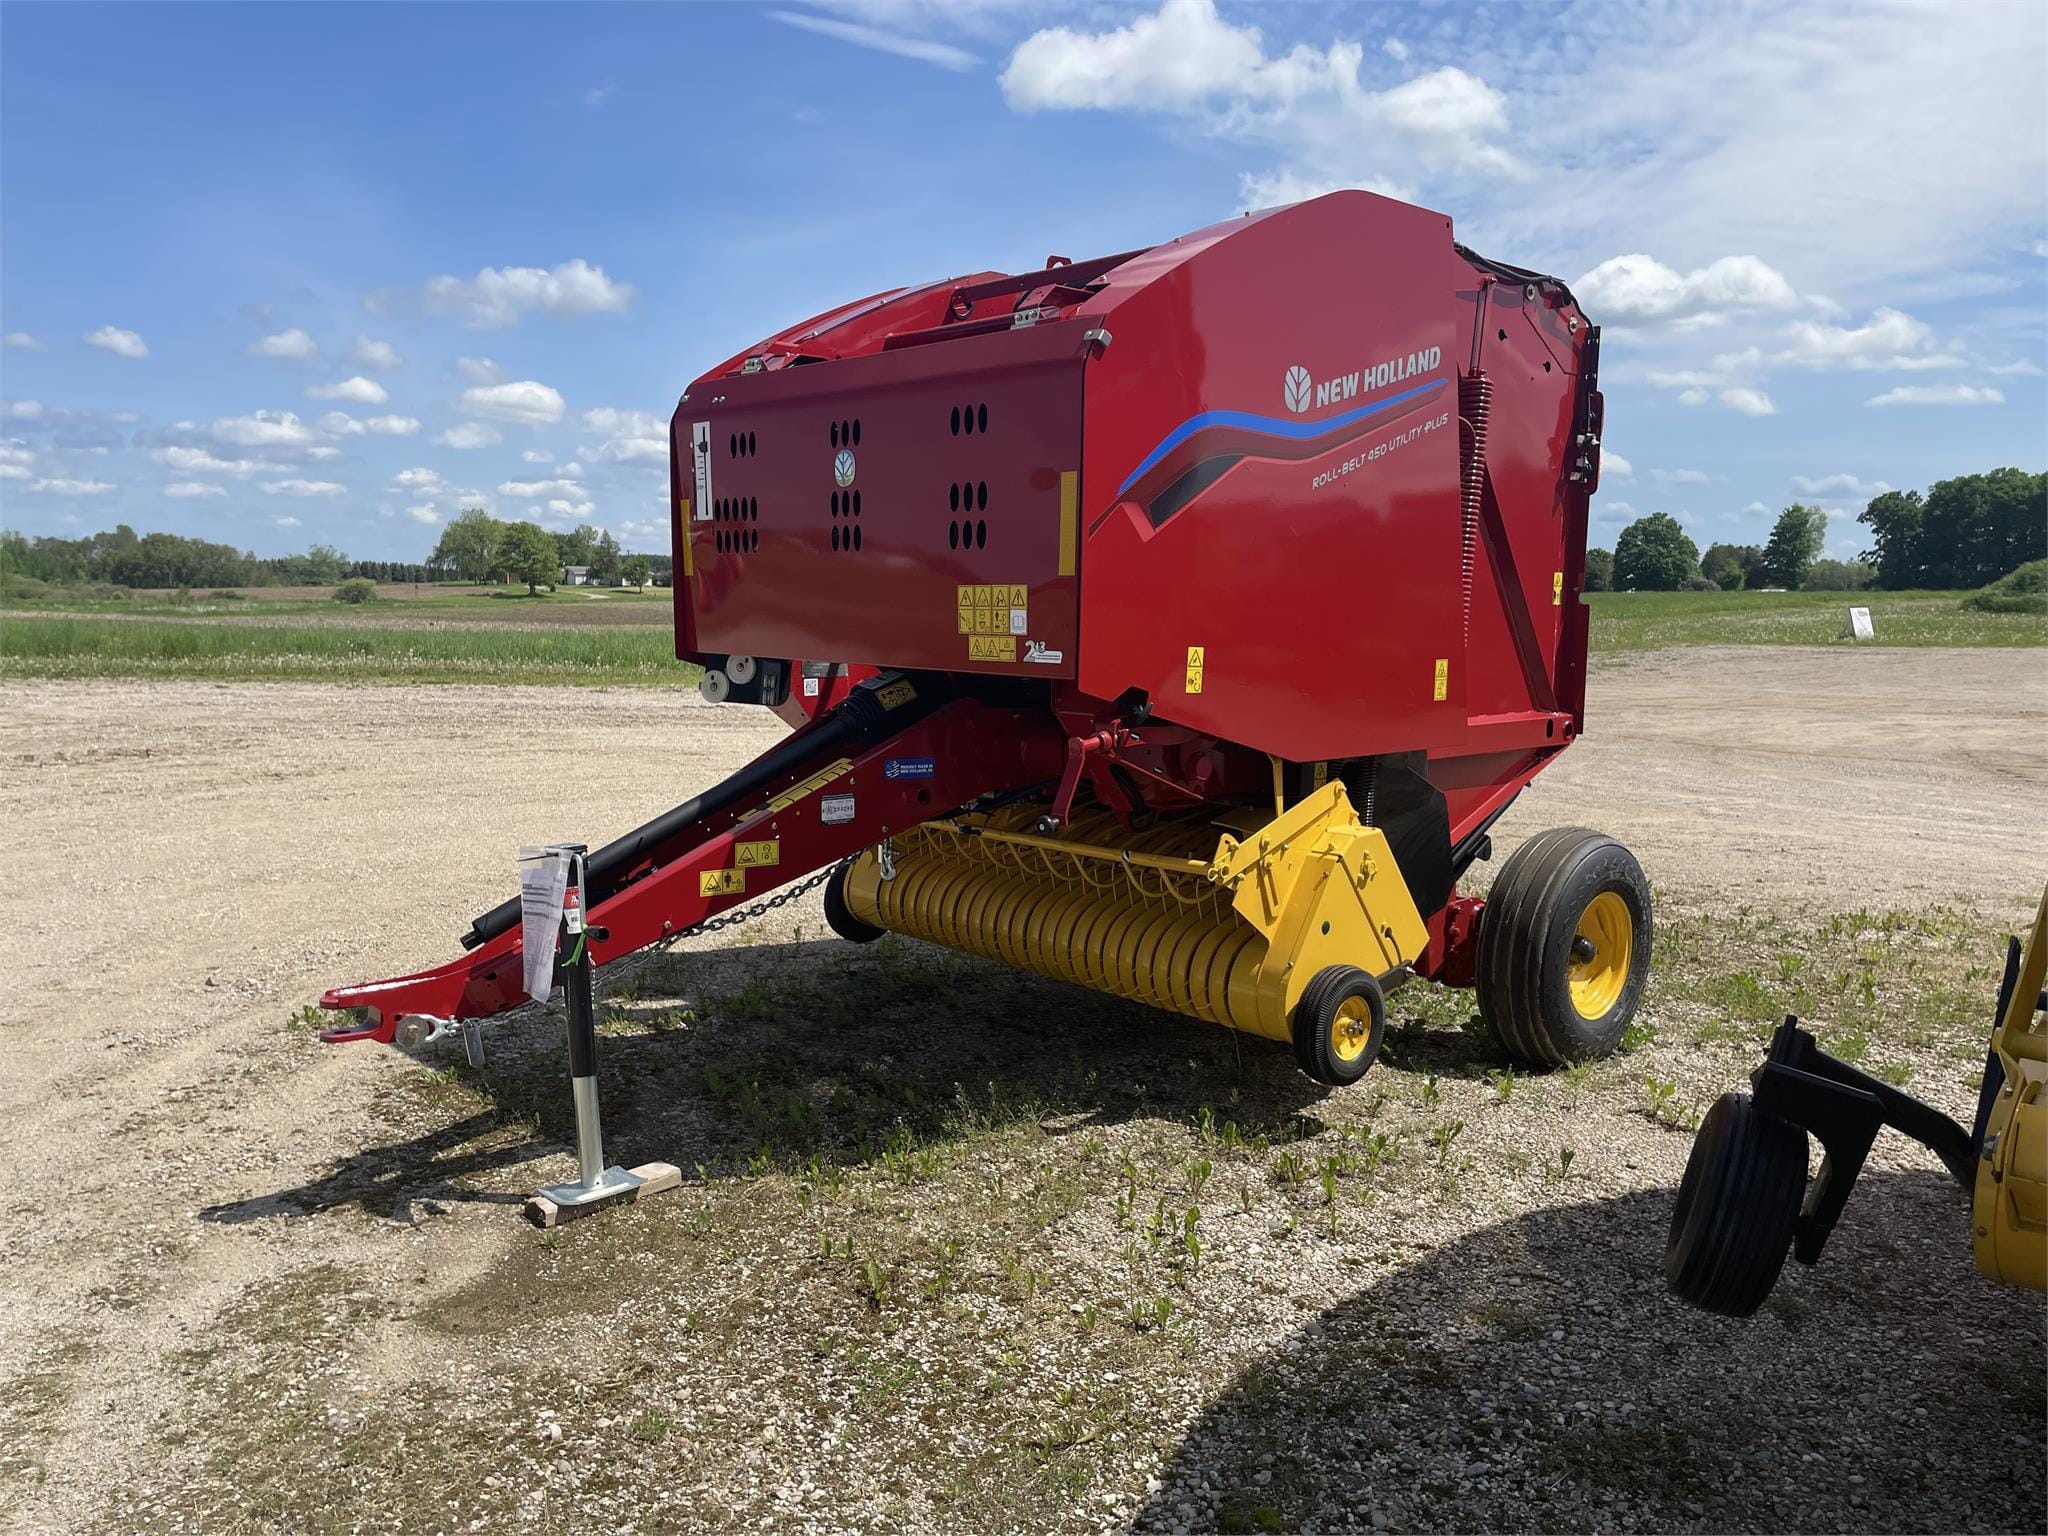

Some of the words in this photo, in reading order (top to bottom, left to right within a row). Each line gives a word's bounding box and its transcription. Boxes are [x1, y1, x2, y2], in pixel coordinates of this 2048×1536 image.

[1316, 372, 1360, 408] NEW
[1364, 346, 1441, 393] HOLLAND
[1312, 453, 1367, 490] ROLL-BELT
[1367, 443, 1387, 461] 450
[1388, 425, 1422, 451] UTILITY
[1424, 412, 1449, 434] PLUS
